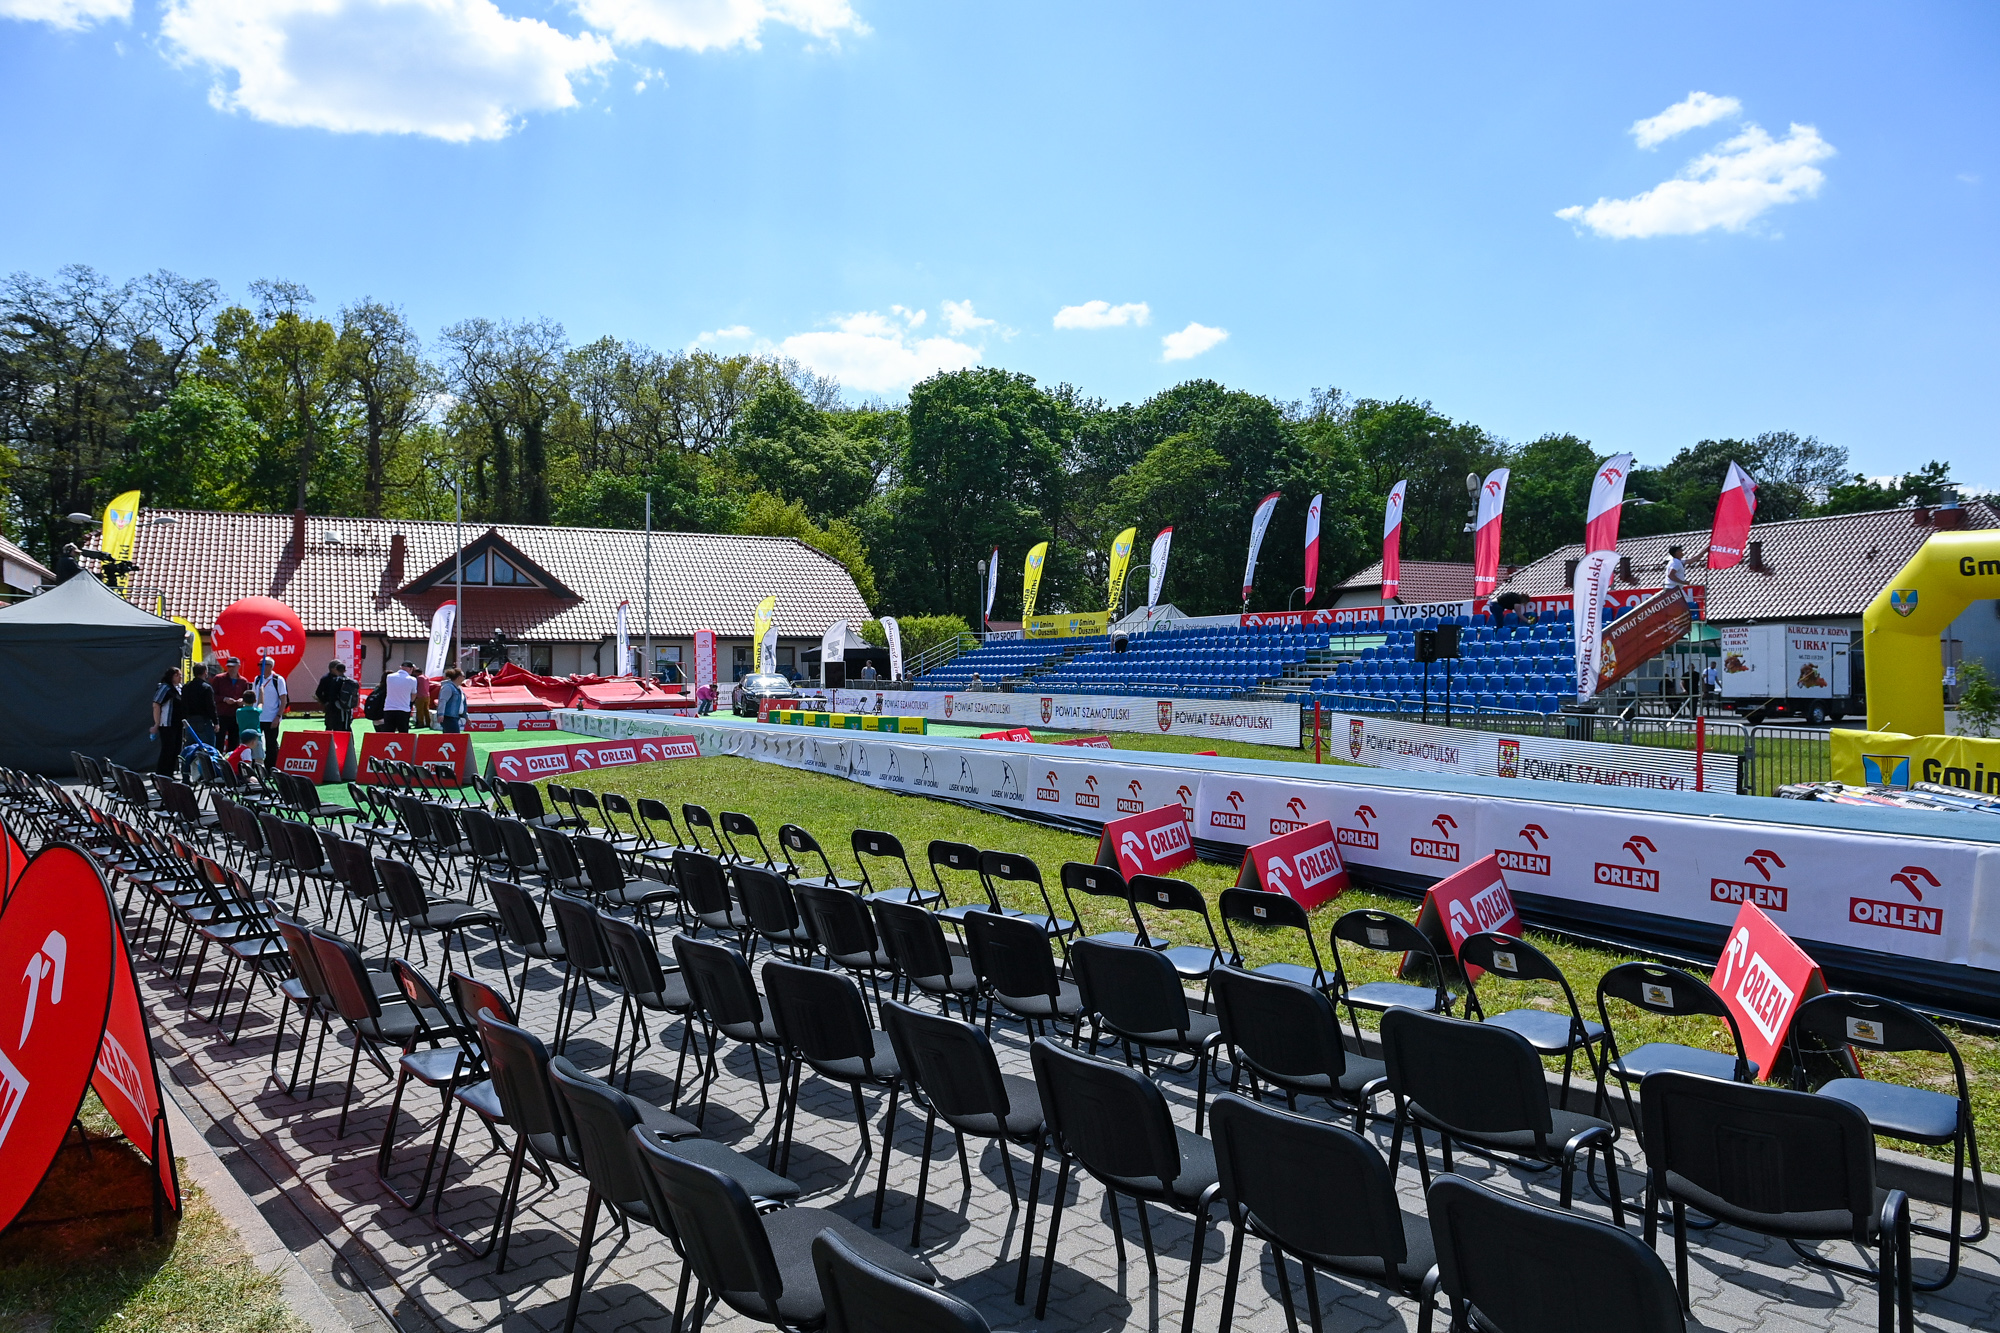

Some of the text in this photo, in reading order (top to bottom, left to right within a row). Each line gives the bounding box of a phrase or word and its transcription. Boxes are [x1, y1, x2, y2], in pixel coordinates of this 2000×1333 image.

[1710, 545, 1740, 556] ORLEN
[1960, 557, 2000, 576] Gm
[1336, 610, 1378, 624] ORLEN
[1392, 604, 1464, 619] TVP SPORT
[1611, 618, 1637, 640] POWIAT
[1637, 589, 1682, 622] SZAMOTULSKI
[1040, 621, 1055, 629] Gmina
[1079, 627, 1100, 635] Duszniki
[1578, 557, 1605, 694] Powiat Szamotulski
[1788, 626, 1819, 635] KURCZAK
[256, 645, 295, 656] ORLEN
[954, 702, 1011, 714] POWIAT SZAMOTULSKI
[1055, 706, 1130, 721] POWIAT SZAMOTULSKI
[1175, 711, 1273, 730] POWIAT SZAMOTULSKI
[1012, 733, 1032, 743] PZLA
[600, 749, 634, 763] ORLEN
[664, 744, 694, 756] ORLEN
[1366, 735, 1459, 764] POWIAT SZAMOTULSKI
[286, 759, 315, 771] ORLEN
[529, 755, 566, 770] ORLEN
[1523, 759, 1572, 782] POWIAT
[1923, 758, 2000, 795] Gmin
[913, 778, 924, 786] LISEK
[927, 780, 939, 788] DOMU
[949, 783, 980, 795] LISEK W DOMU
[991, 789, 1025, 802] LISEK W DOMU
[1038, 789, 1059, 801] ORLEN
[1076, 794, 1099, 807] ORLEN
[1118, 799, 1143, 813] ORLEN
[1212, 813, 1244, 828] ORLEN
[1151, 826, 1188, 855] ORLEN
[1338, 830, 1377, 847] ORLEN
[1412, 841, 1457, 859] ORLEN
[1299, 847, 1338, 883] ORLEN
[1497, 852, 1548, 873] ORLEN
[1597, 865, 1656, 889] ORLEN
[1714, 882, 1784, 909] ORLEN
[1476, 886, 1511, 929] ORLEN
[1853, 901, 1937, 931] ORLEN
[1743, 963, 1788, 1034] ORLEN
